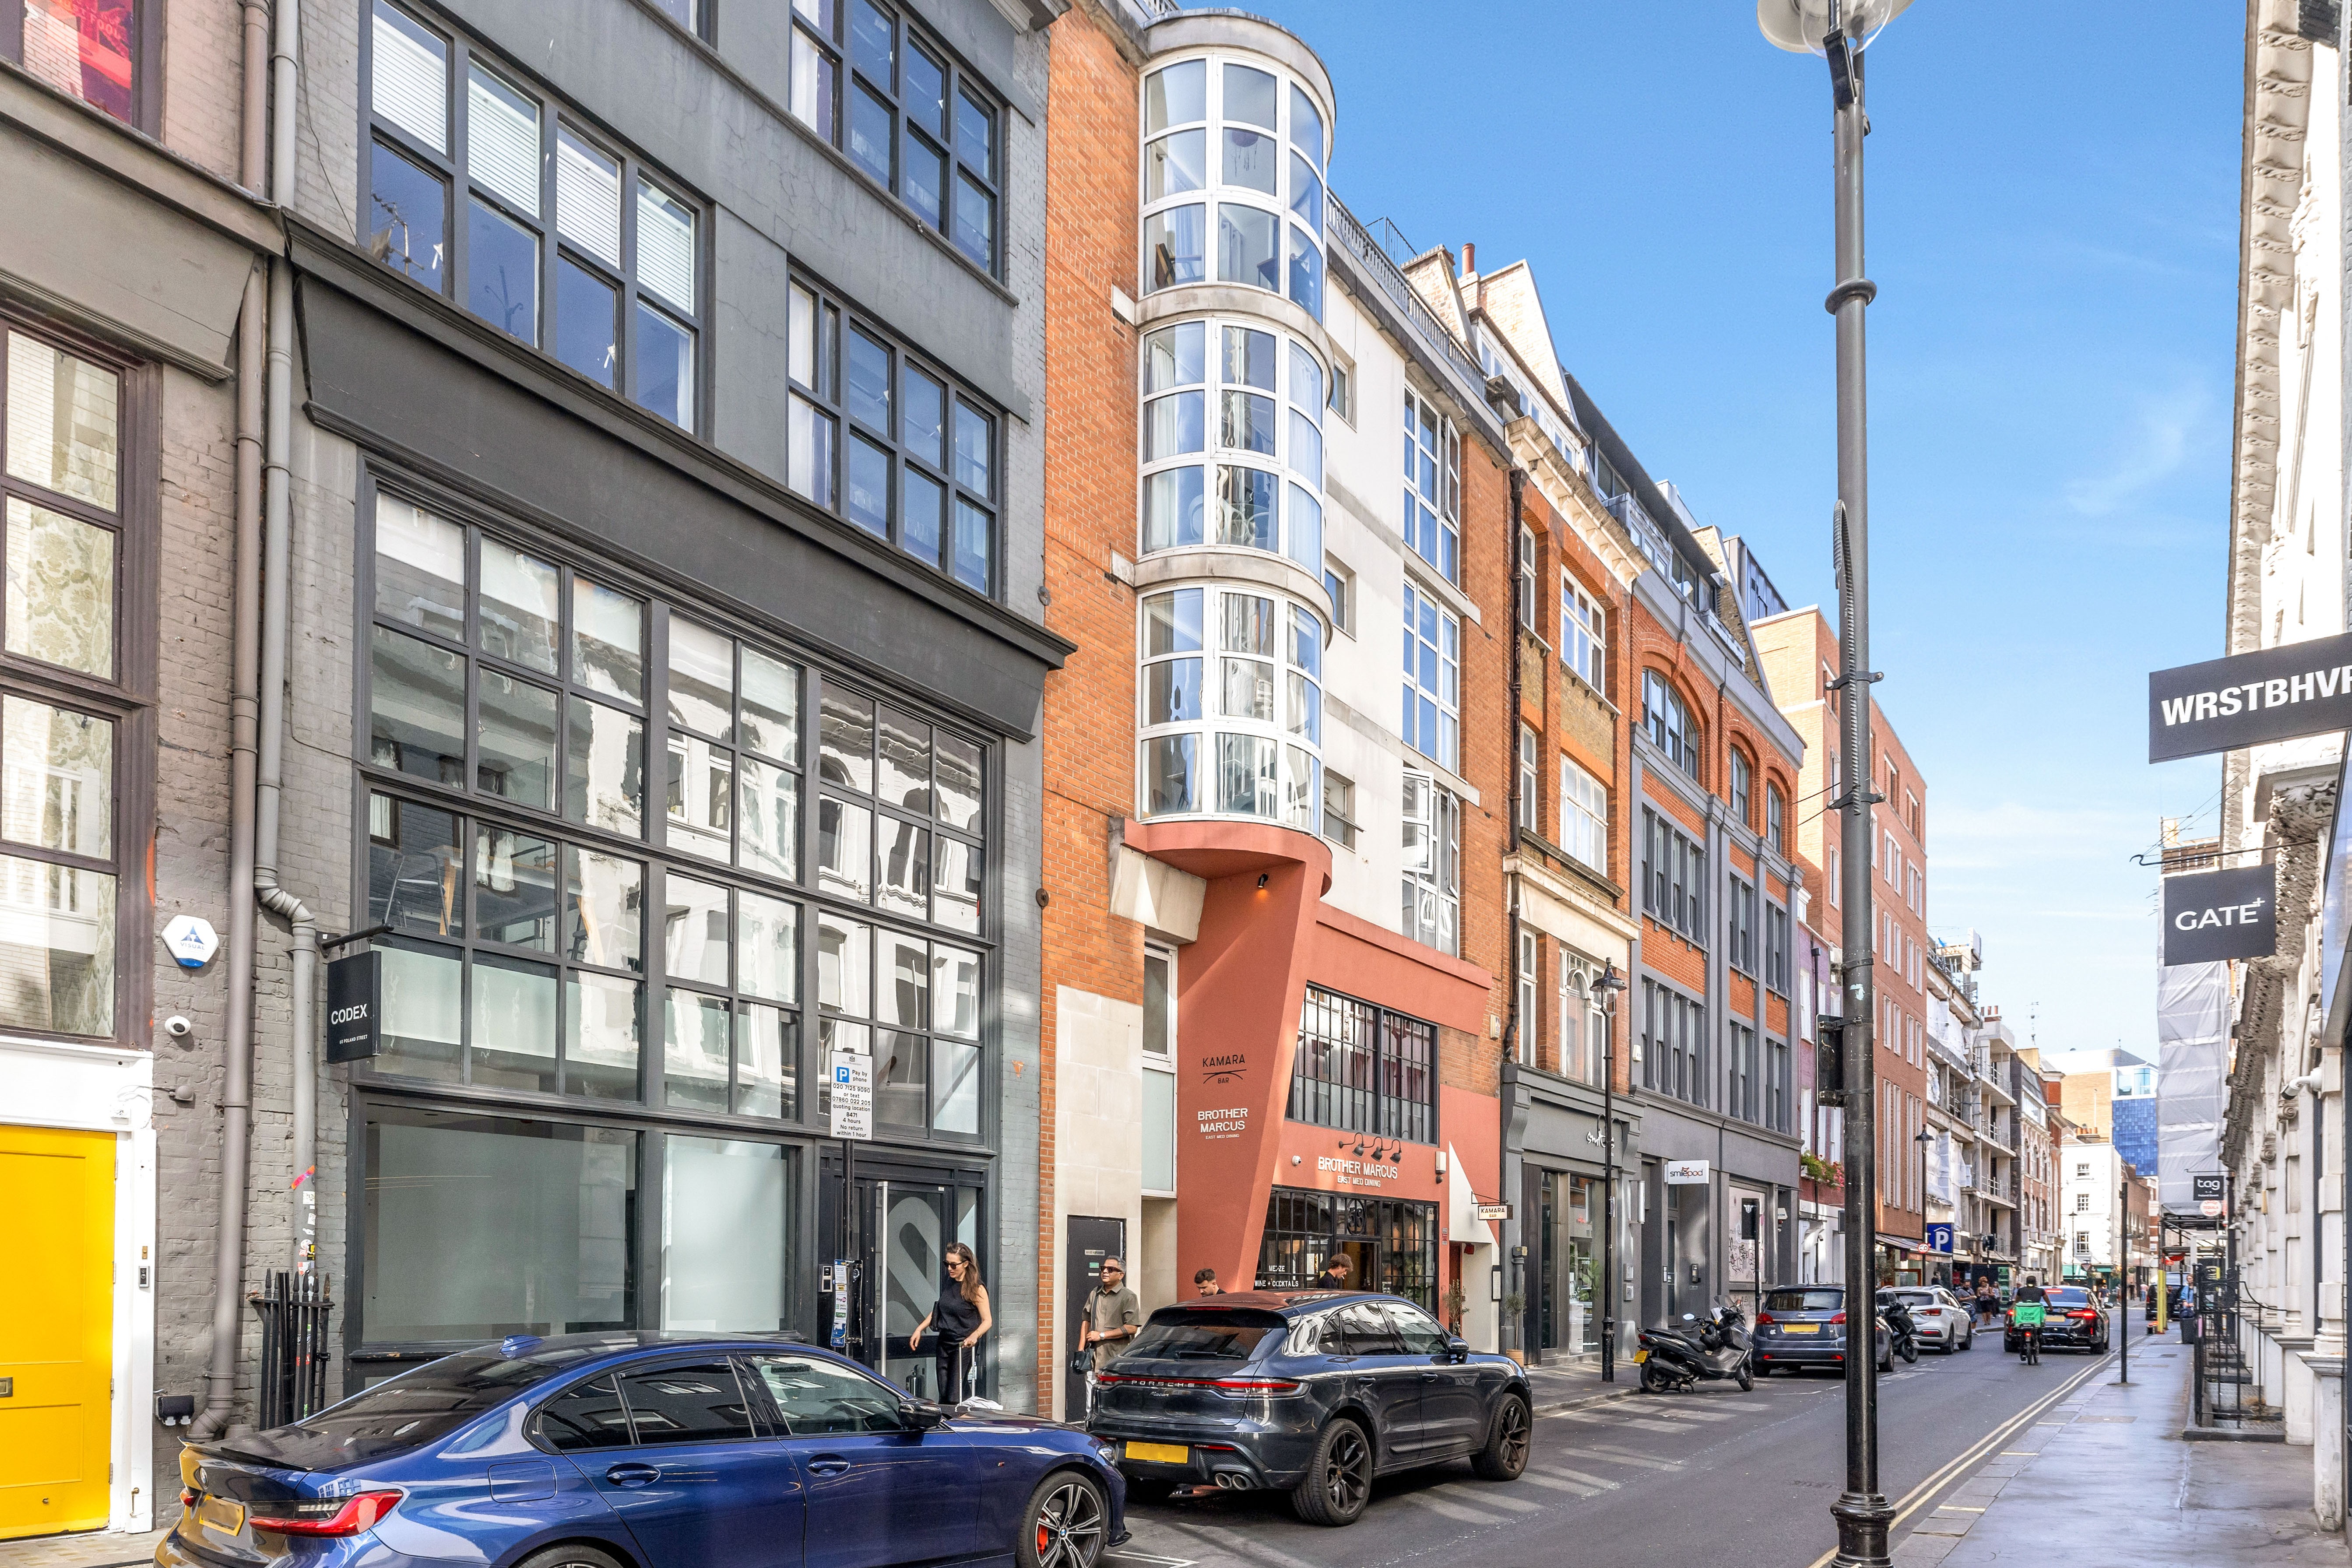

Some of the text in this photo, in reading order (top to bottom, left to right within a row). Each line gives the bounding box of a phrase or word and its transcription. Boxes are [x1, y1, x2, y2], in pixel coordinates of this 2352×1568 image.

[180, 942, 205, 950] VISUAL
[331, 1003, 368, 1025] CODEX
[1203, 1054, 1245, 1067] KAMARA
[839, 1069, 847, 1081] P
[1198, 1107, 1248, 1121] BROTHER
[1200, 1121, 1245, 1132] MARCUS
[1318, 1156, 1398, 1179] BROTHER MARCUS
[1337, 1175, 1351, 1184] EAST
[1364, 1178, 1381, 1187] DINING
[2197, 1179, 2220, 1190] tag
[1936, 1231, 1949, 1252] P
